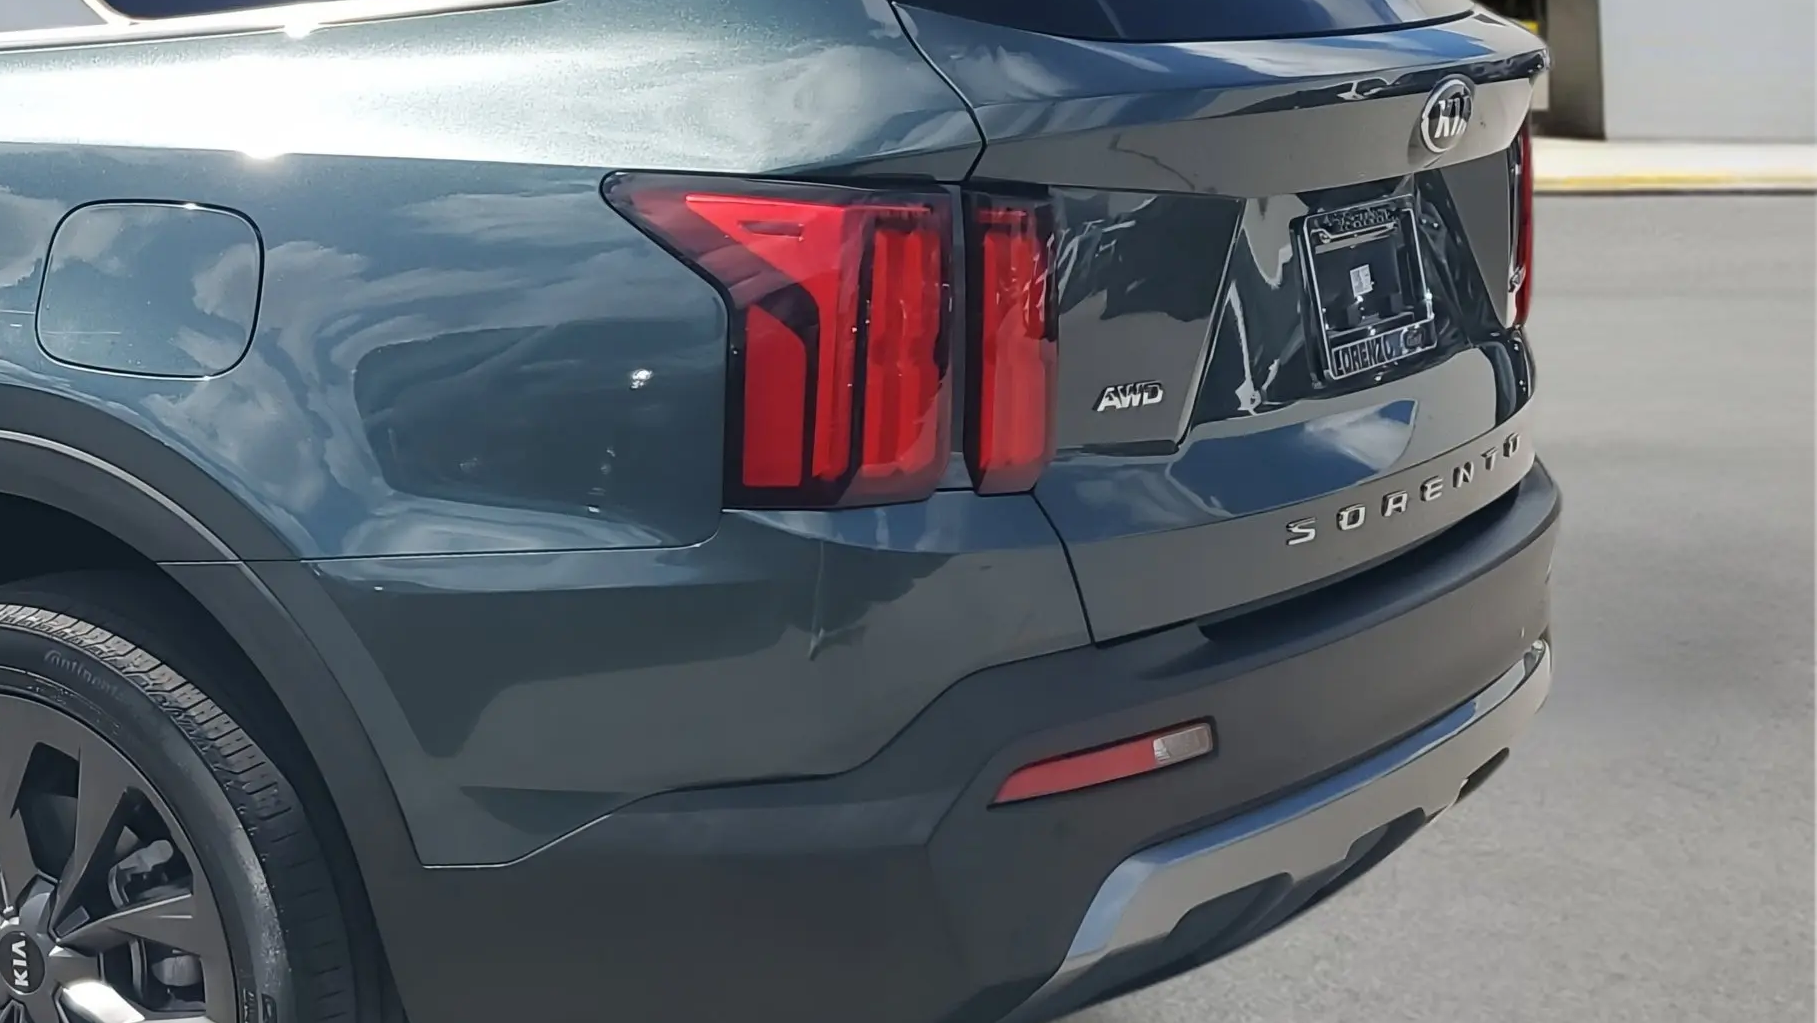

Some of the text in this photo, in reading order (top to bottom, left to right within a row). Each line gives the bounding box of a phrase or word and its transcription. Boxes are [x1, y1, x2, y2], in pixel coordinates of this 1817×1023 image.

[1434, 96, 1471, 138] KIA
[1092, 380, 1164, 412] AWD
[1285, 432, 1521, 546] SORENTO
[11, 939, 29, 987] KIA
